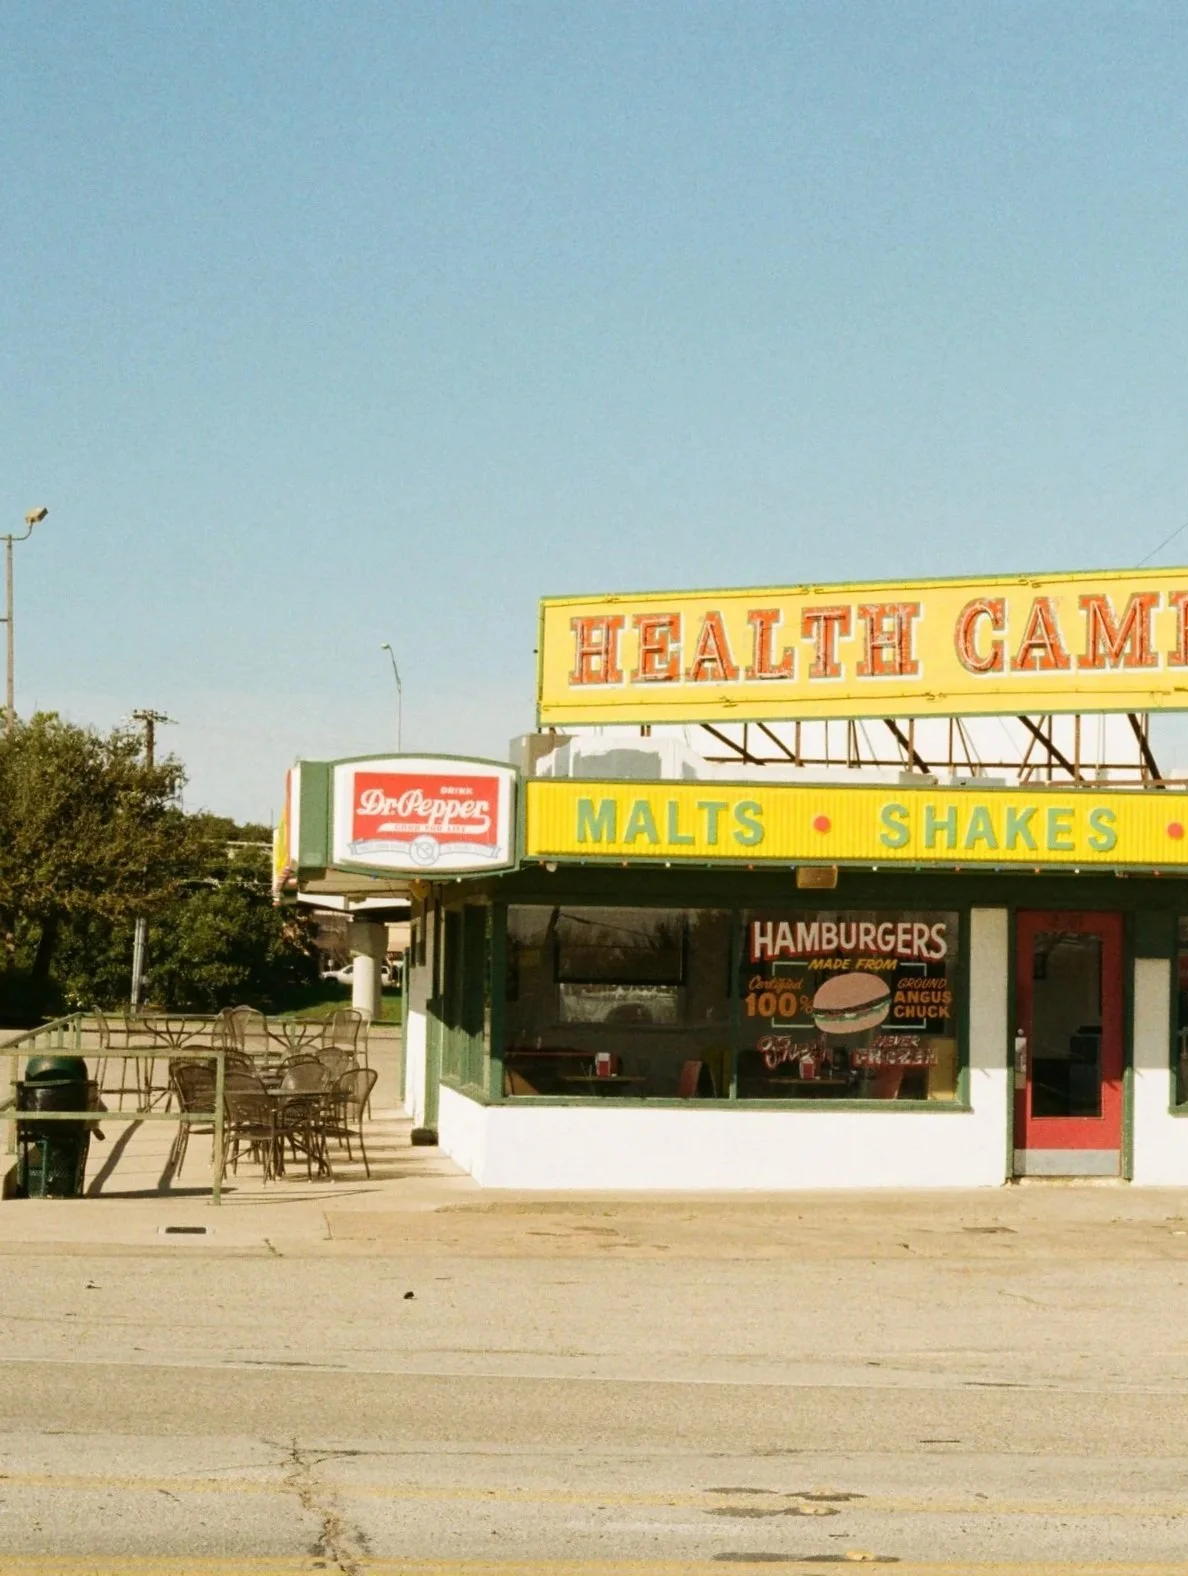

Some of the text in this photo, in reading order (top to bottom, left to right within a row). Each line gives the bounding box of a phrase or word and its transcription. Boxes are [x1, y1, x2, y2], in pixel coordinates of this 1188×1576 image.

[568, 600, 923, 688] HEALTH
[440, 785, 474, 796] DRINK
[397, 789, 491, 835] Pepper
[576, 798, 766, 847] MALTS
[878, 802, 1119, 853] SHAKES
[751, 920, 950, 963] HAMBURGERS
[807, 958, 899, 971] MADE FROM
[748, 974, 804, 994] Certified
[896, 976, 948, 990] GROUND
[744, 991, 815, 1018] 100%
[893, 990, 953, 1004] ANGUS
[892, 1004, 951, 1018] CHUCK
[872, 1035, 921, 1048] NEVER
[853, 1048, 940, 1067] FROZEN
